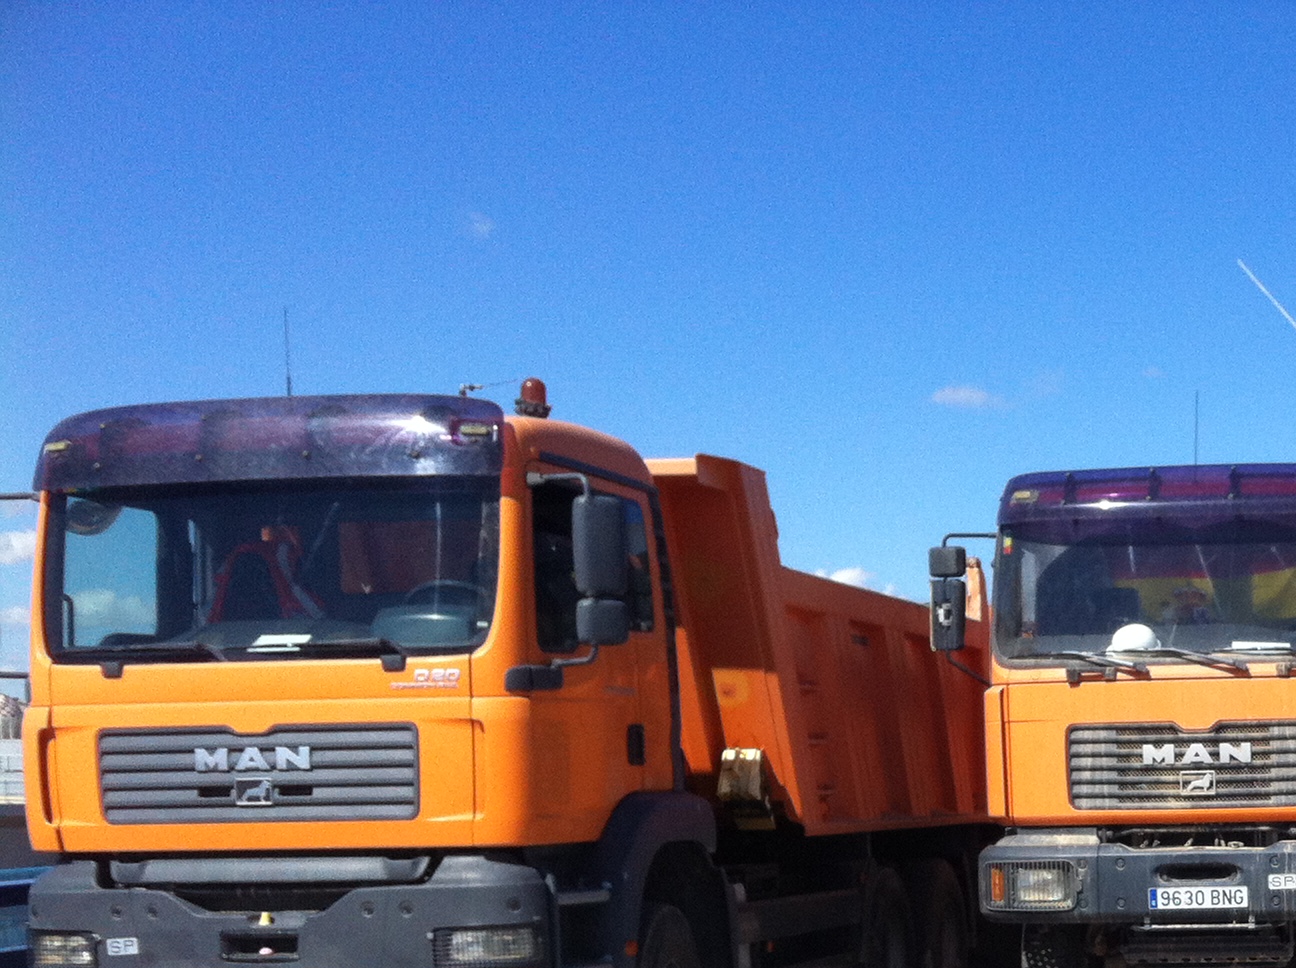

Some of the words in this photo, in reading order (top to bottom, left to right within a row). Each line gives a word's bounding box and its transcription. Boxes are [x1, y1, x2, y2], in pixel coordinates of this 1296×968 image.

[194, 746, 311, 771] MAN
[1142, 742, 1252, 764] MAN
[1160, 890, 1205, 906] 9630
[1210, 889, 1244, 905] BNG
